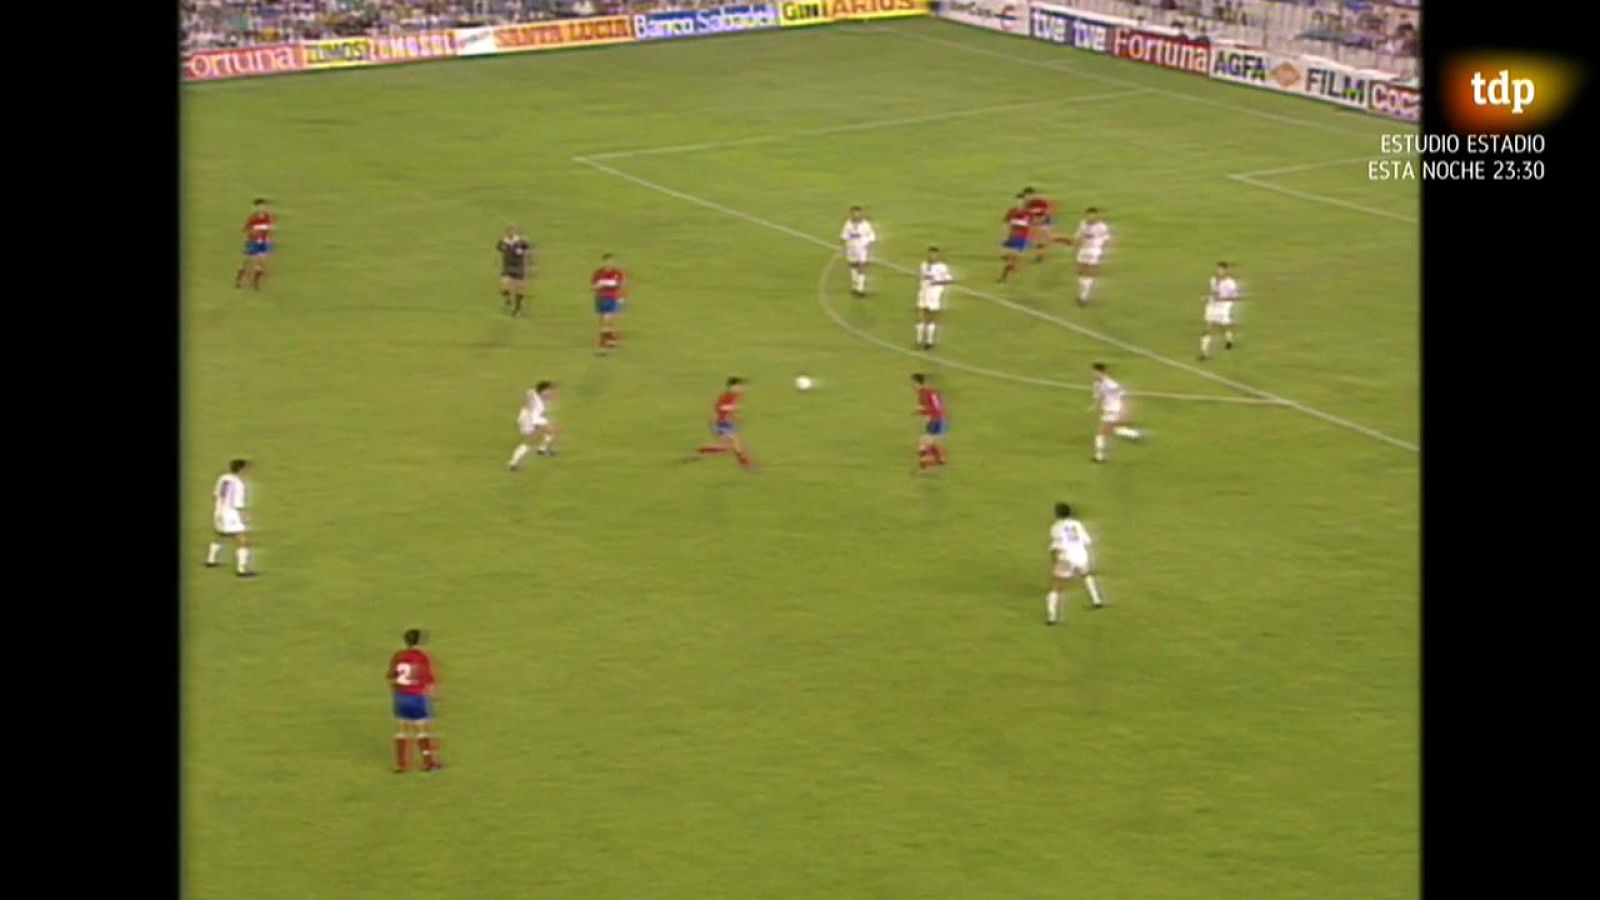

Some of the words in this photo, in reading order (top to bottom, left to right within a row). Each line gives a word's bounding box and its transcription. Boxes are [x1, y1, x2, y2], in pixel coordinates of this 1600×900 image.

[633, 14, 694, 39] Banco
[1113, 26, 1208, 73] Fortuna
[1212, 50, 1267, 82] AGFA
[1305, 67, 1365, 105] FILM
[396, 662, 412, 685] 2
